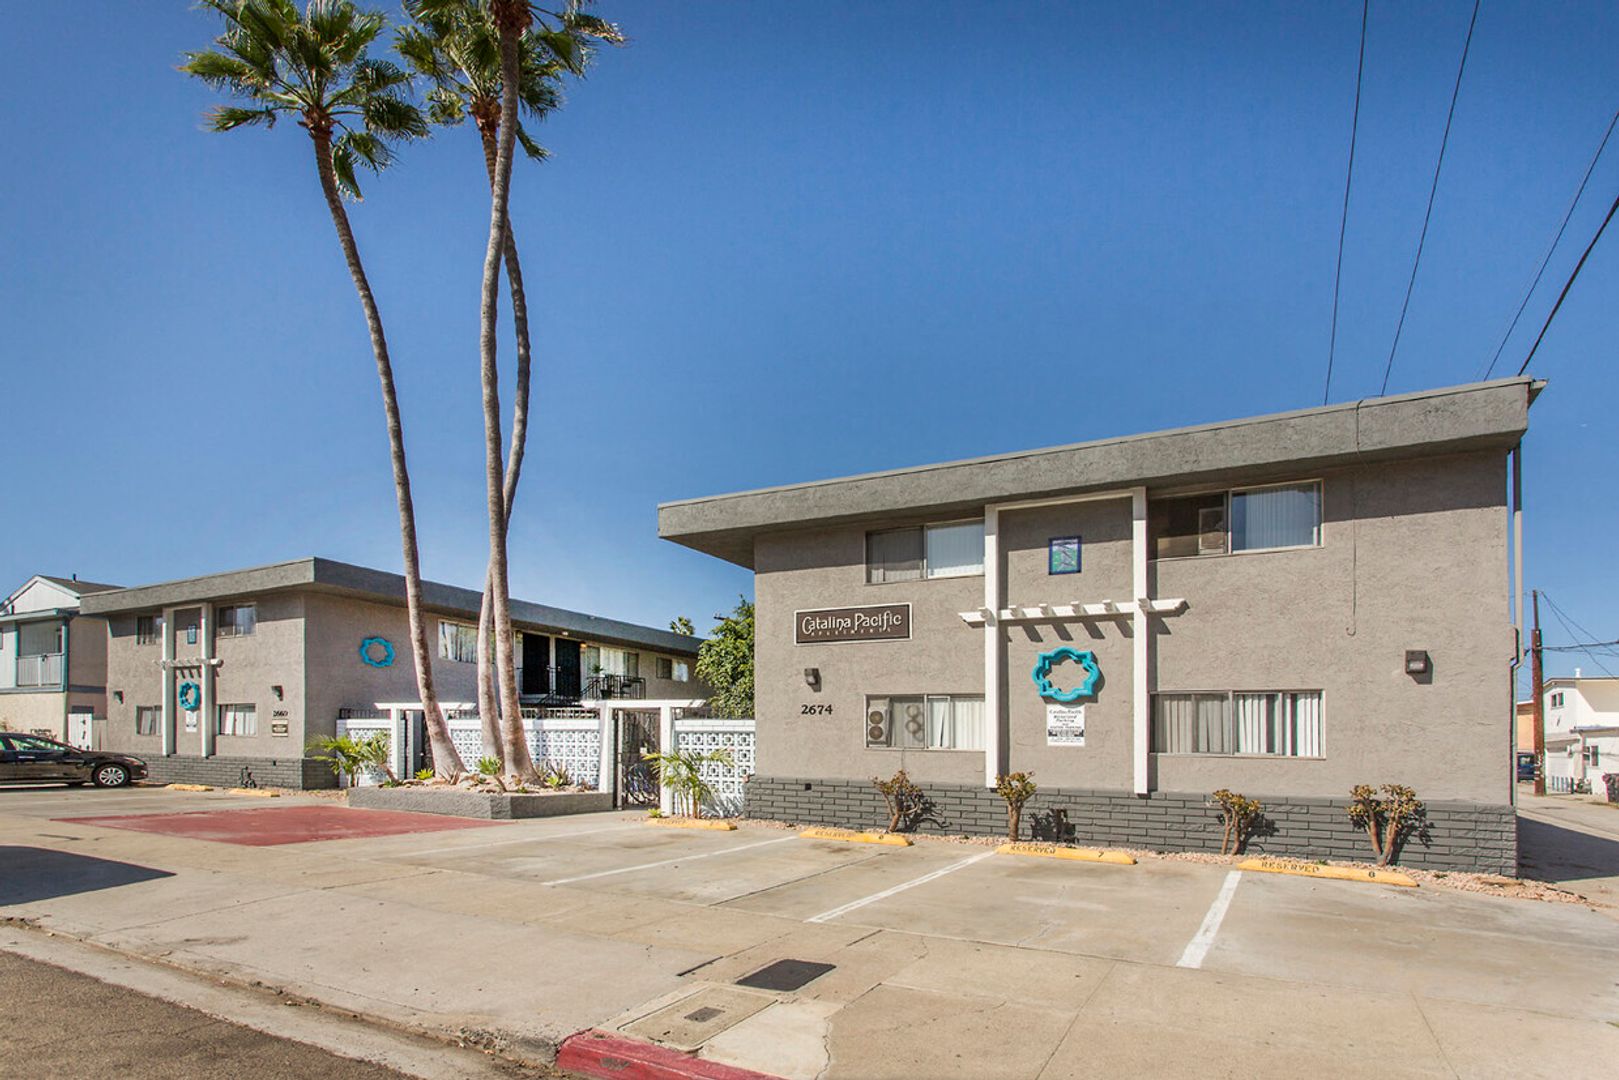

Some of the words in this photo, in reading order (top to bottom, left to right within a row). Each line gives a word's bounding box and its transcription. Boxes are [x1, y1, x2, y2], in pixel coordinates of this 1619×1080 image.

[802, 616, 852, 635] Catalina
[854, 610, 902, 631] Pacific
[801, 703, 834, 716] 2674
[1010, 845, 1057, 855] RESERVED
[1260, 861, 1321, 873] RESERVED
